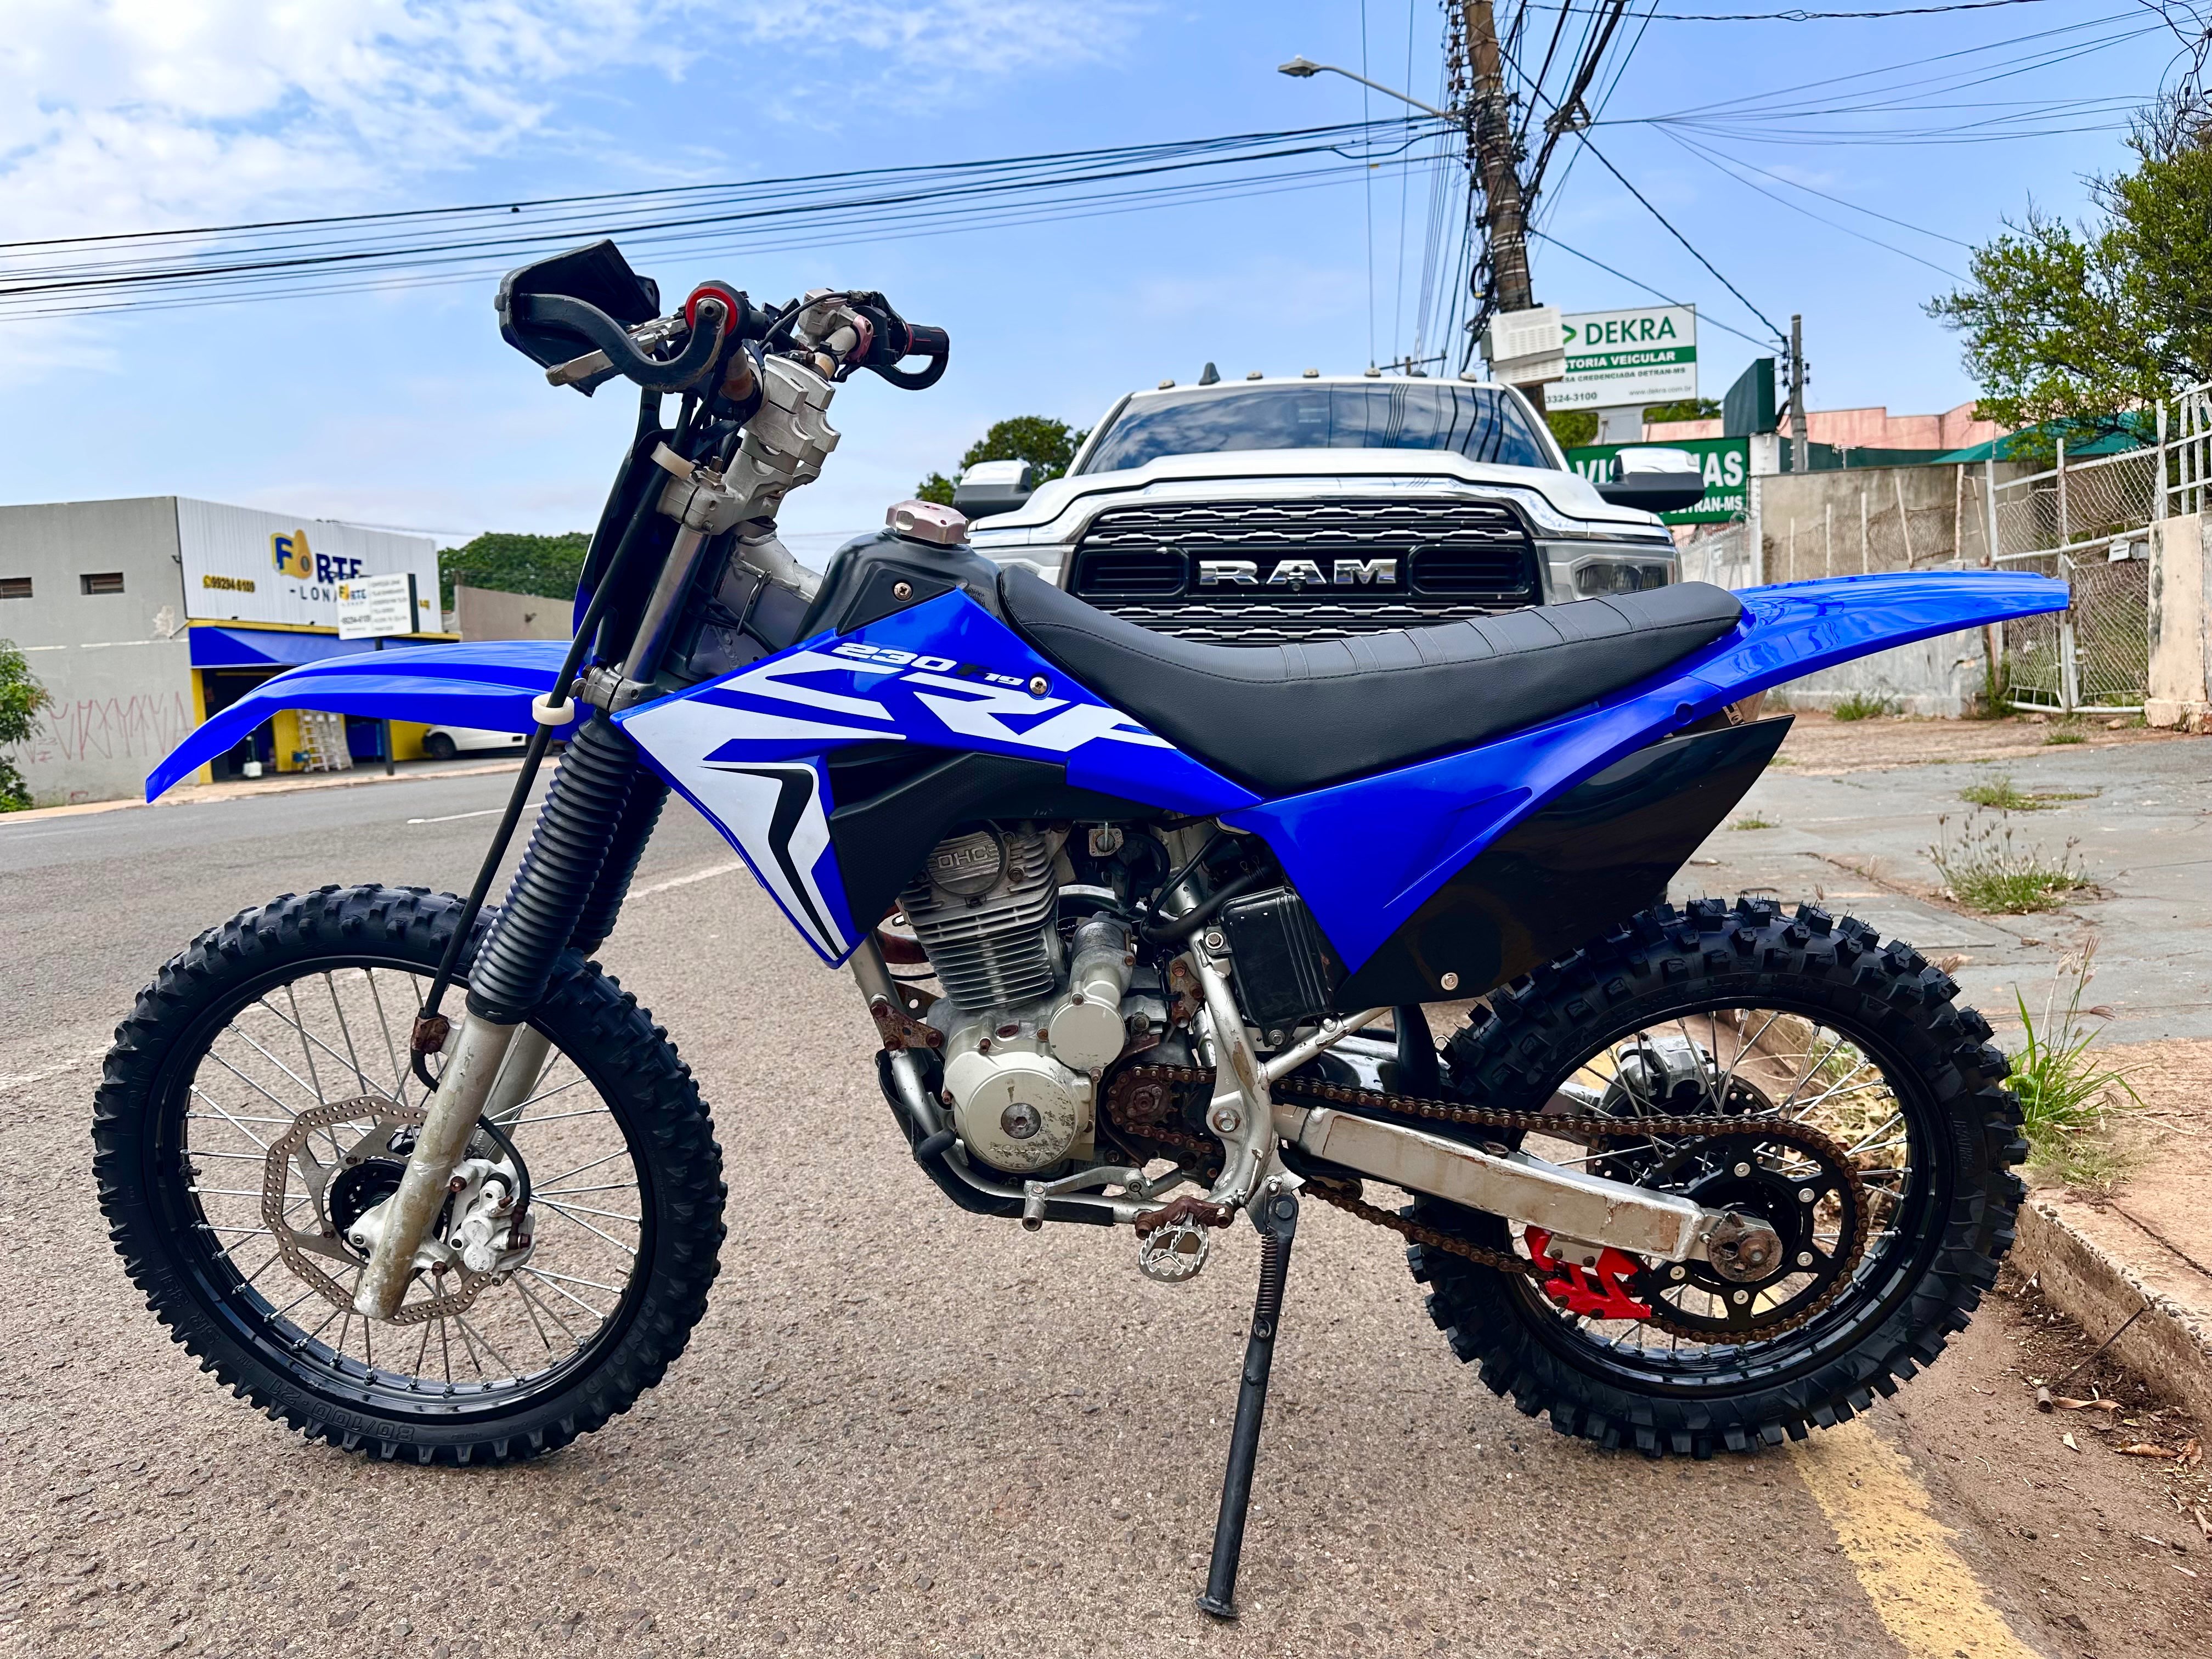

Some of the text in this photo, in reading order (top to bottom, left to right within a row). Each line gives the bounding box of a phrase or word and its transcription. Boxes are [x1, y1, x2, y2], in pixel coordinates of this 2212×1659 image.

[1585, 316, 1677, 346] DEKRA
[1610, 351, 1675, 366] VEICULAR
[1577, 371, 1635, 382] CREDENCIADA
[1638, 367, 1685, 377] DETRAN-MS
[1199, 558, 1398, 585] RAM
[831, 642, 957, 672] 230
[984, 673, 1025, 686] 19
[938, 846, 988, 868] OHC
